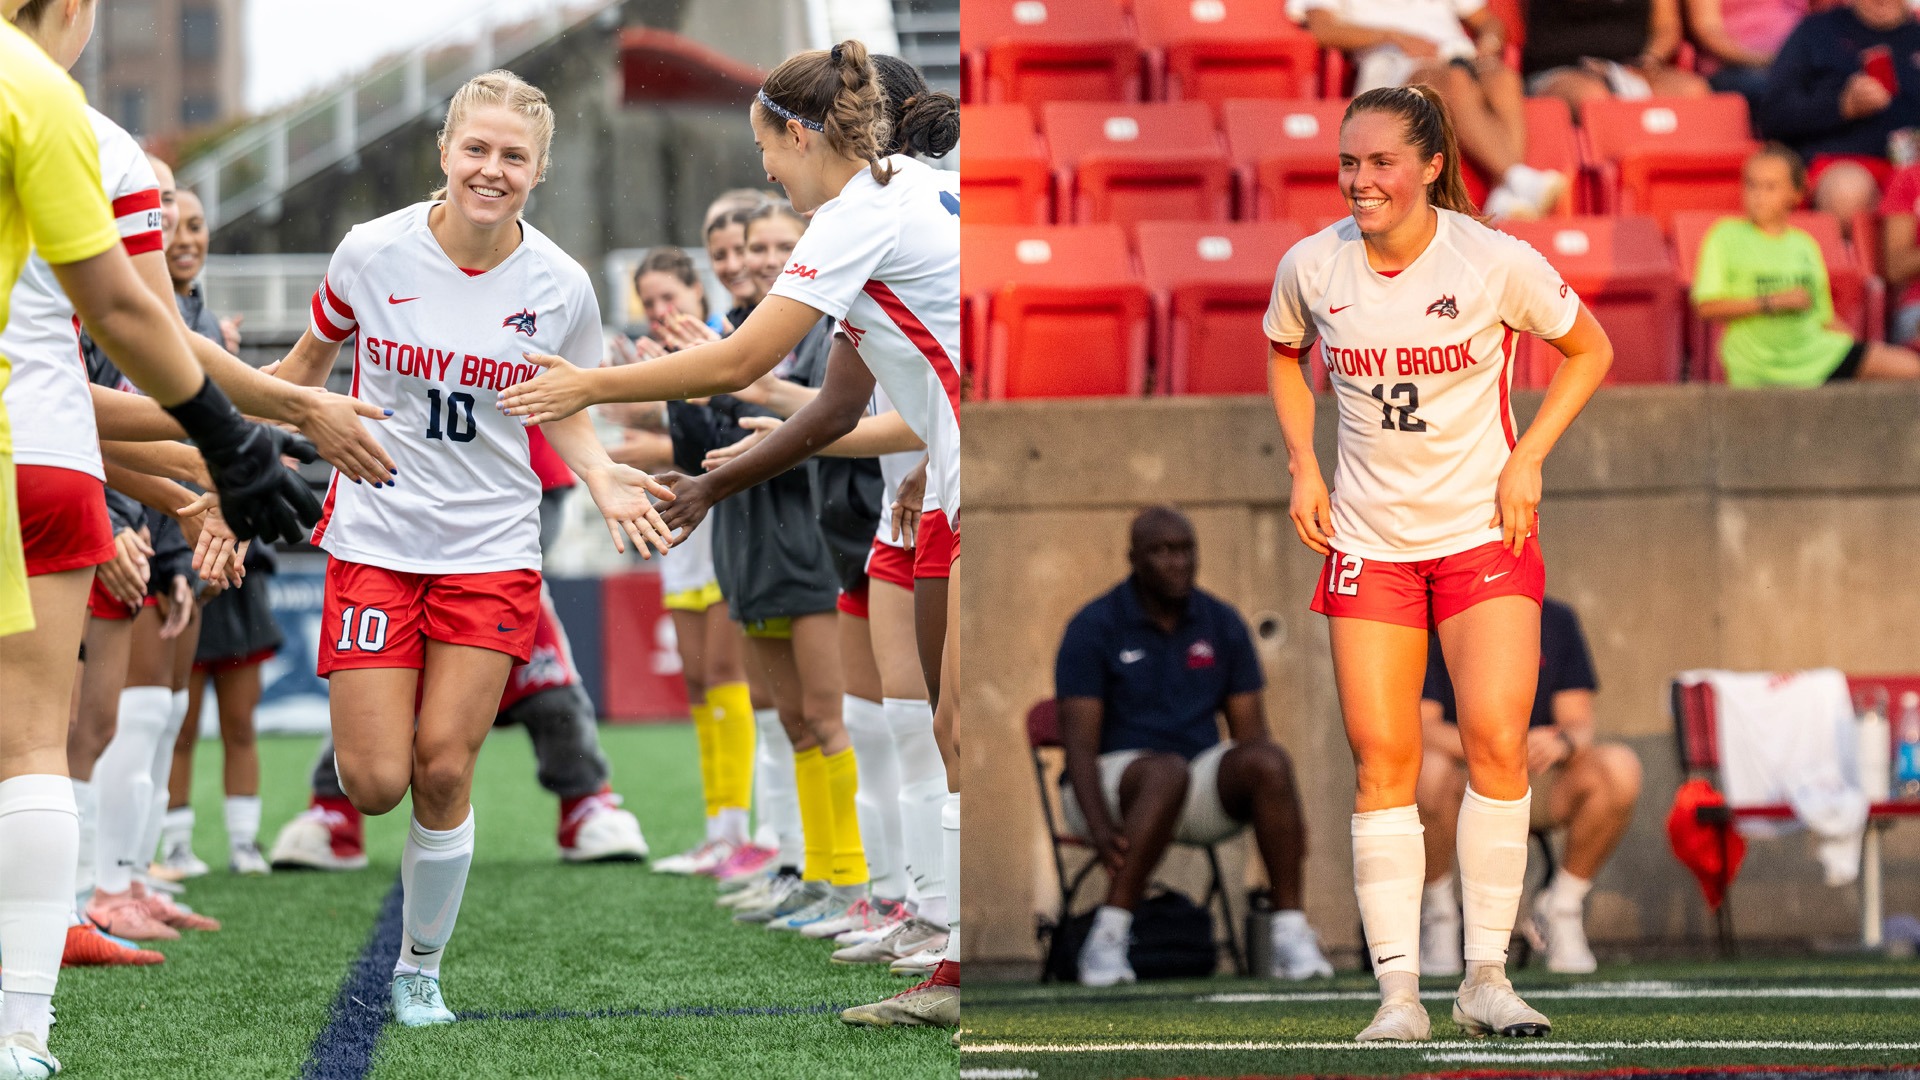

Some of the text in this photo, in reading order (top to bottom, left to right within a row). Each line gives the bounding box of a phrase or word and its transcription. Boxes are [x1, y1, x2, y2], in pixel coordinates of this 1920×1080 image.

[366, 336, 455, 382] STONY
[1325, 338, 1478, 377] STONY BROOK
[426, 388, 477, 443] 10
[1371, 382, 1427, 433] 12
[1328, 551, 1365, 598] 12
[336, 605, 390, 653] 10
